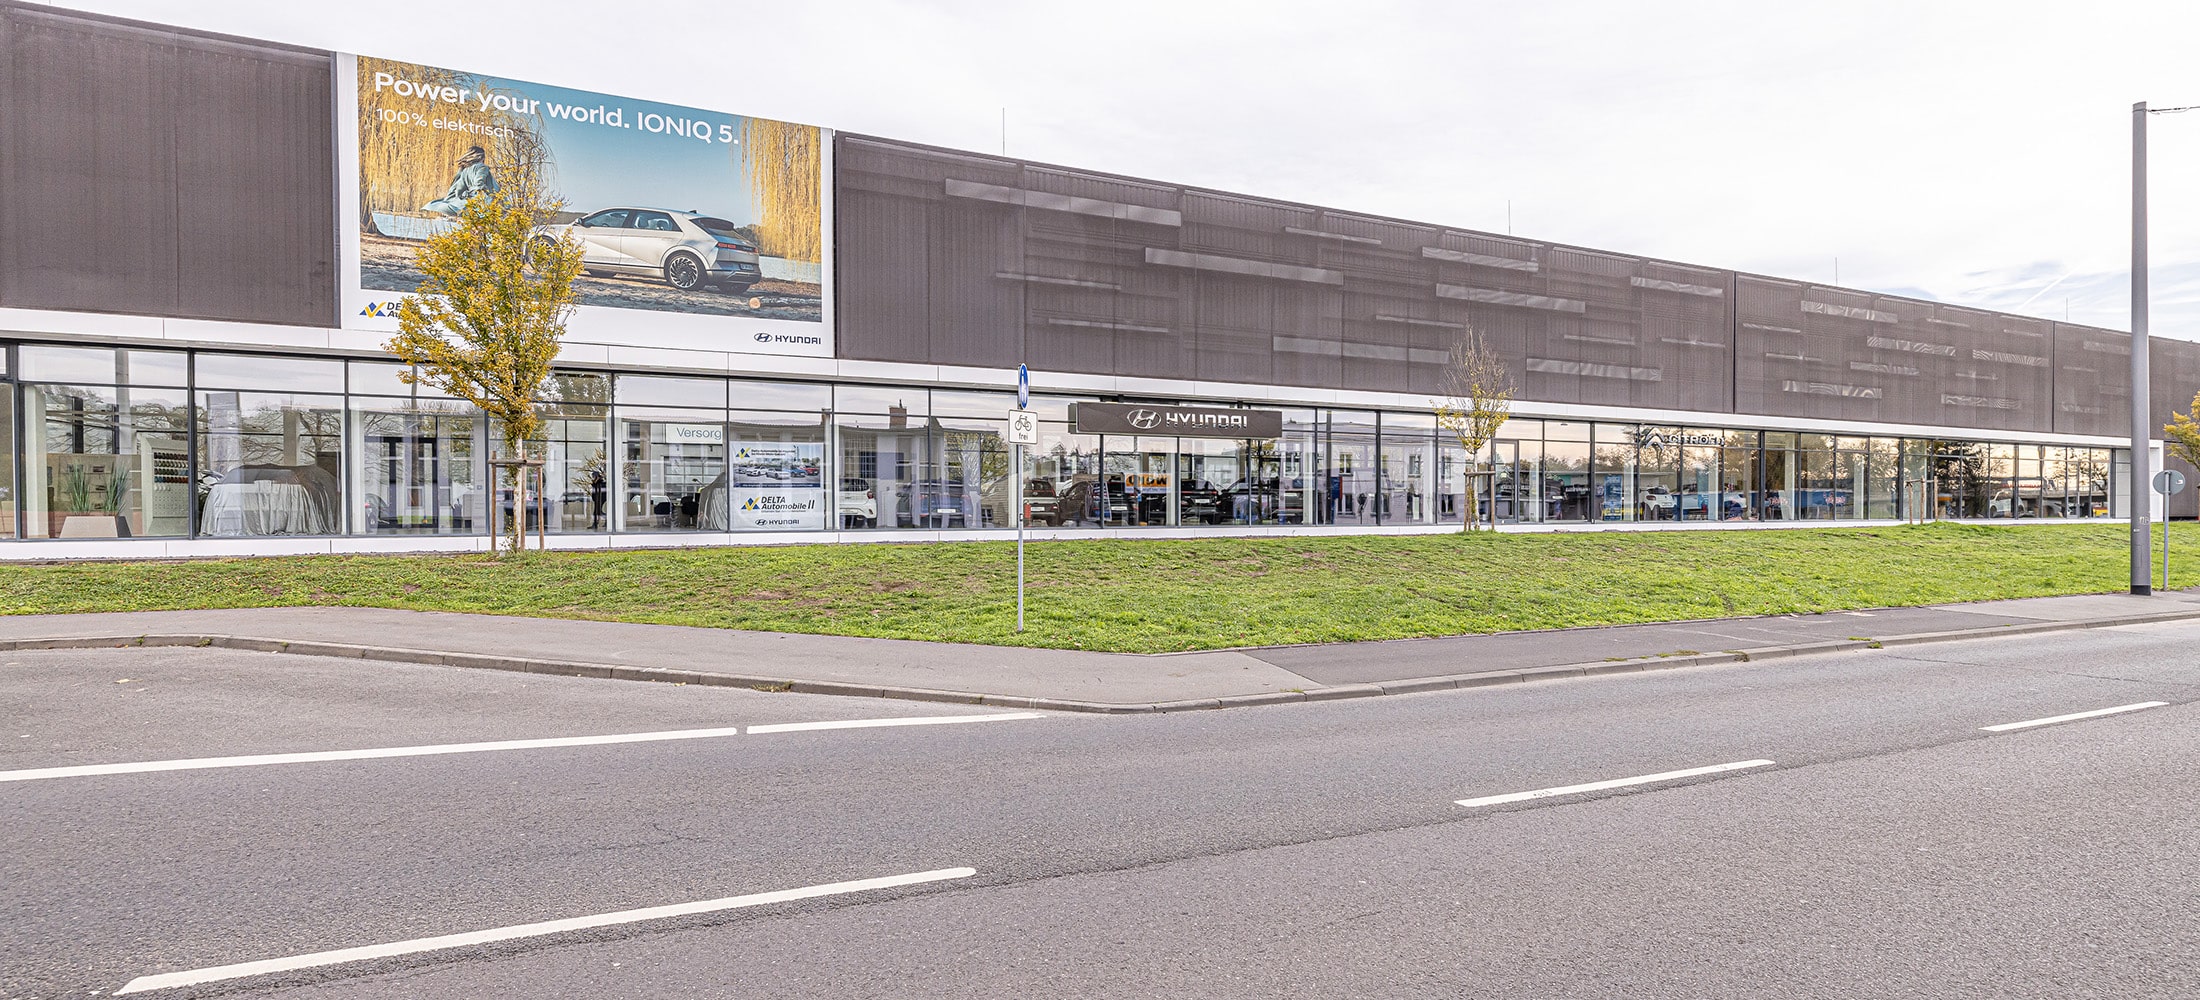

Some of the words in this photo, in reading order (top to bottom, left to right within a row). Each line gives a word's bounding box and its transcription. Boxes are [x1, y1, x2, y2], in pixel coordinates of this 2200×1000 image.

[374, 72, 470, 105] Power
[476, 91, 540, 115] your
[546, 102, 630, 129] world.
[637, 112, 712, 144] IONIQ
[718, 124, 739, 145] 5.
[376, 107, 428, 127] 100%
[775, 335, 821, 344] HYUNDAI
[1166, 412, 1248, 429] HYUNDAI
[676, 427, 722, 441] Versorg
[1018, 432, 1029, 441] frei
[761, 496, 786, 504] DELTA
